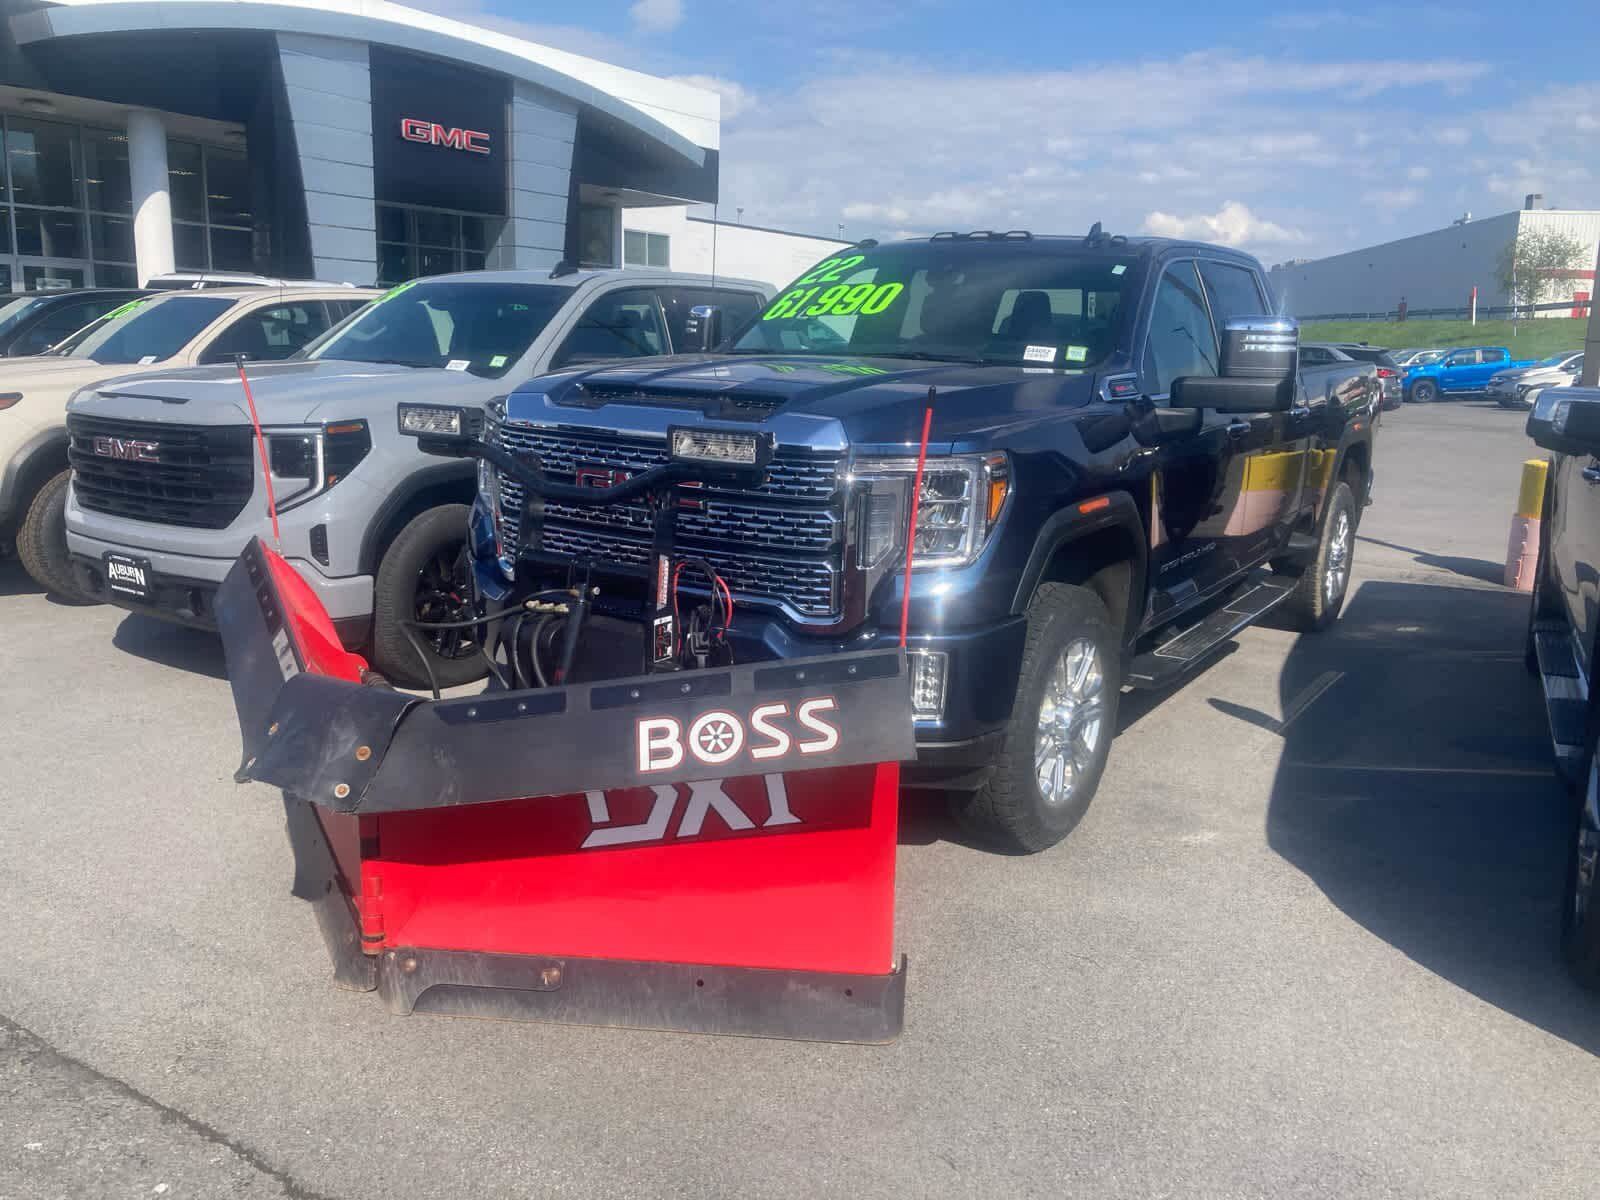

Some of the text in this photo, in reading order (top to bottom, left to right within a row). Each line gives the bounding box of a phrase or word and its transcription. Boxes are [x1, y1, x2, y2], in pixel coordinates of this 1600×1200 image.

[401, 118, 490, 155] GMC
[796, 255, 865, 286] 22
[94, 436, 160, 463] GMC
[108, 562, 146, 587] AUBURN
[636, 696, 840, 773] BOSS
